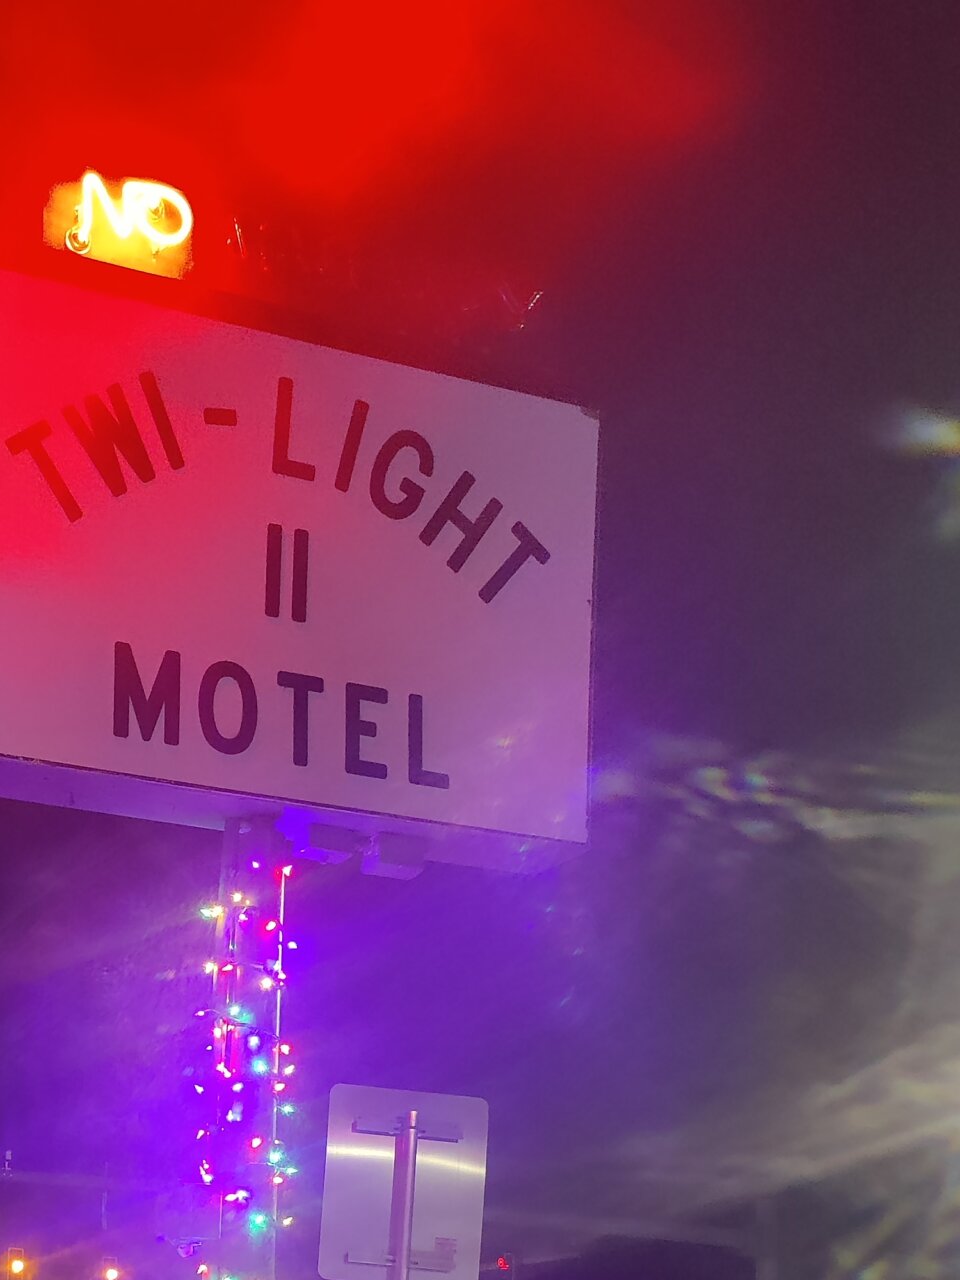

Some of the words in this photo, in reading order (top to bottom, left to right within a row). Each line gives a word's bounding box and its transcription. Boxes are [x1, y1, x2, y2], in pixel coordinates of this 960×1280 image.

[78, 168, 194, 247] NO
[264, 522, 310, 624] II
[112, 640, 450, 790] MOTEL
